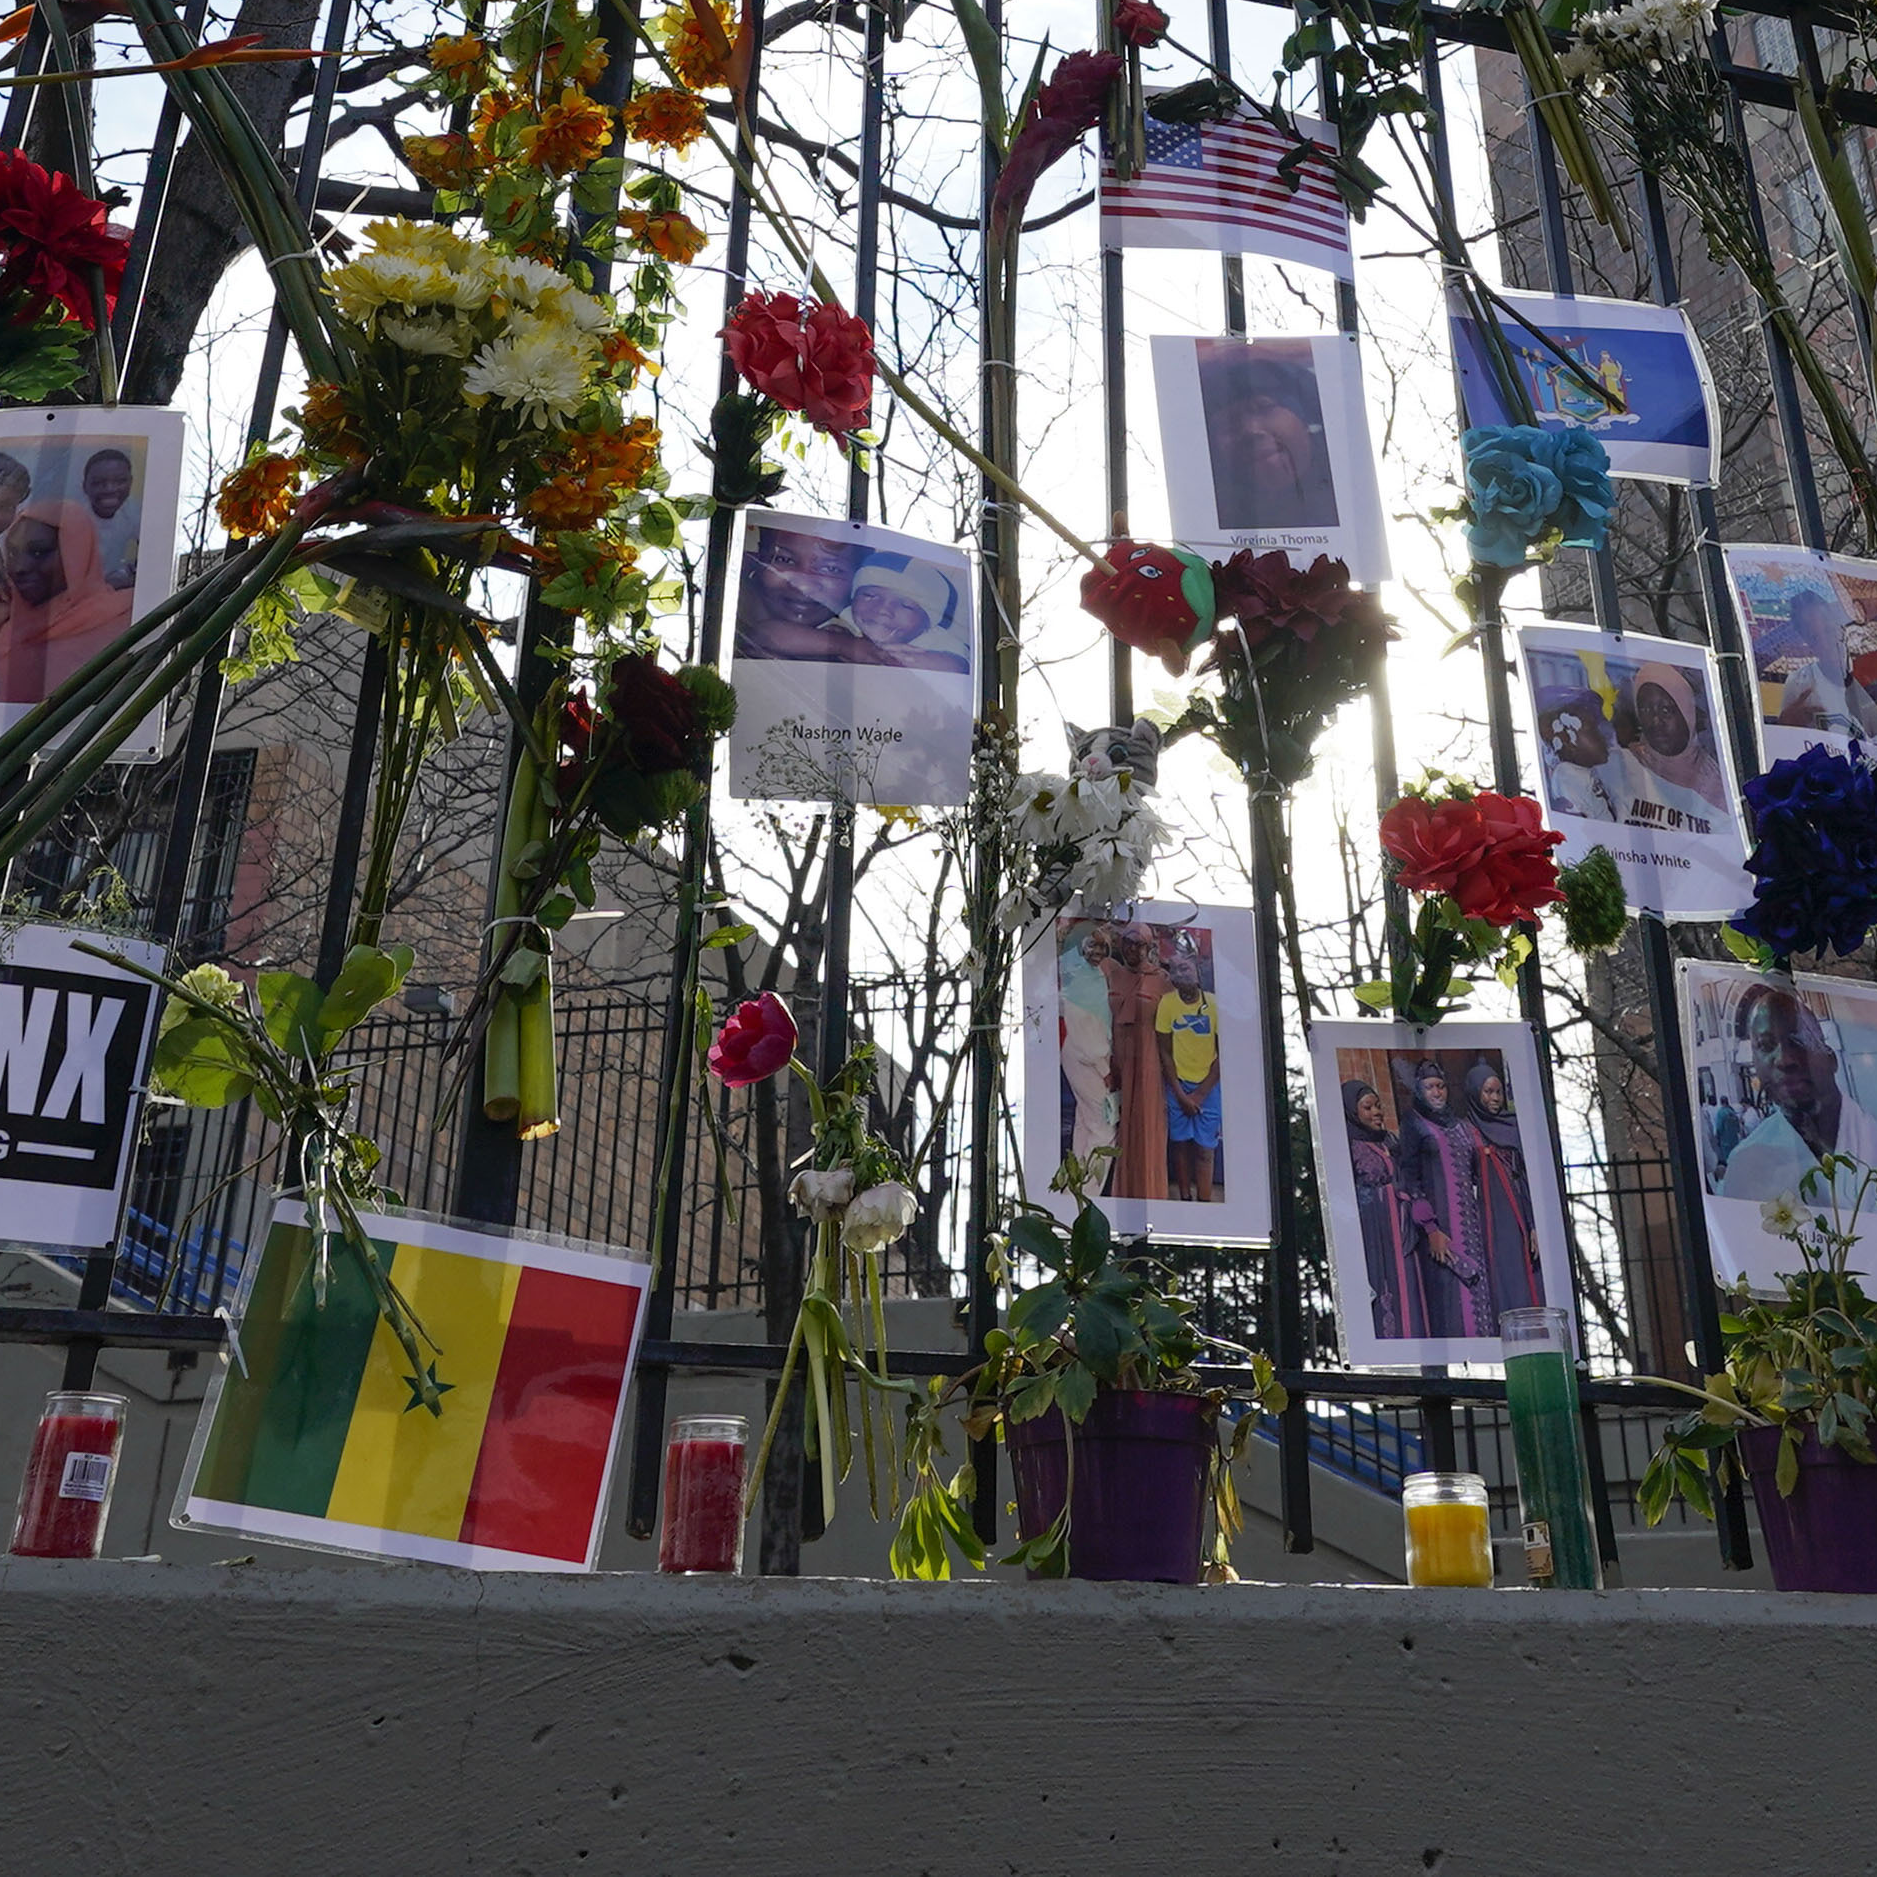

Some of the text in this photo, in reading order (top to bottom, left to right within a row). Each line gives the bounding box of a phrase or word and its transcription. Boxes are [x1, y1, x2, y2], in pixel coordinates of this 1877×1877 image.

[1230, 533, 1329, 548] Virginia Thomas
[792, 724, 903, 743] Nashon Wade
[1631, 798, 1665, 822] AUNT
[1667, 807, 1684, 829] OF
[1686, 814, 1712, 835] THE
[1650, 851, 1692, 869] White
